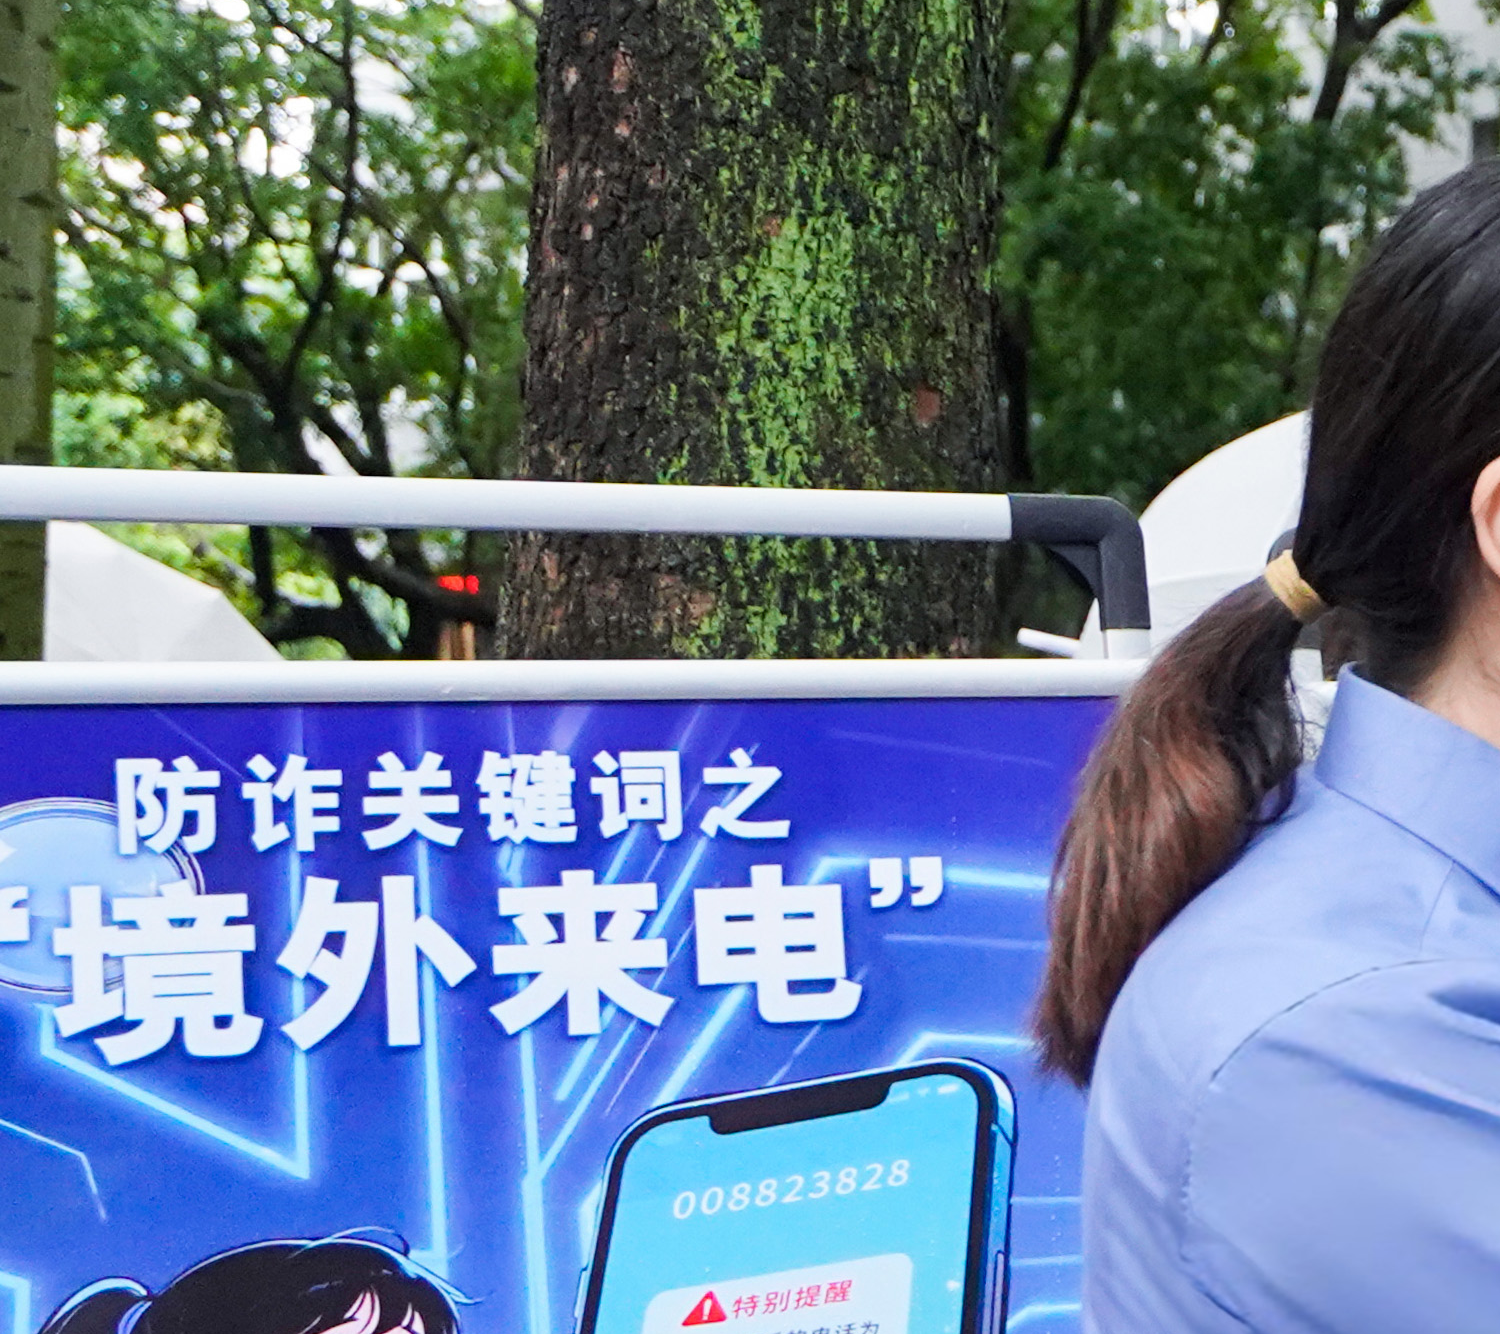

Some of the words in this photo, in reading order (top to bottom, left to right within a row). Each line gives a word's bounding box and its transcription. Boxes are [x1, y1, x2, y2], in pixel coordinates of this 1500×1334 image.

[115, 748, 792, 857] 防诈关键词之
[673, 1158, 911, 1220] 008823828
[731, 1279, 853, 1320] 特别提醒
